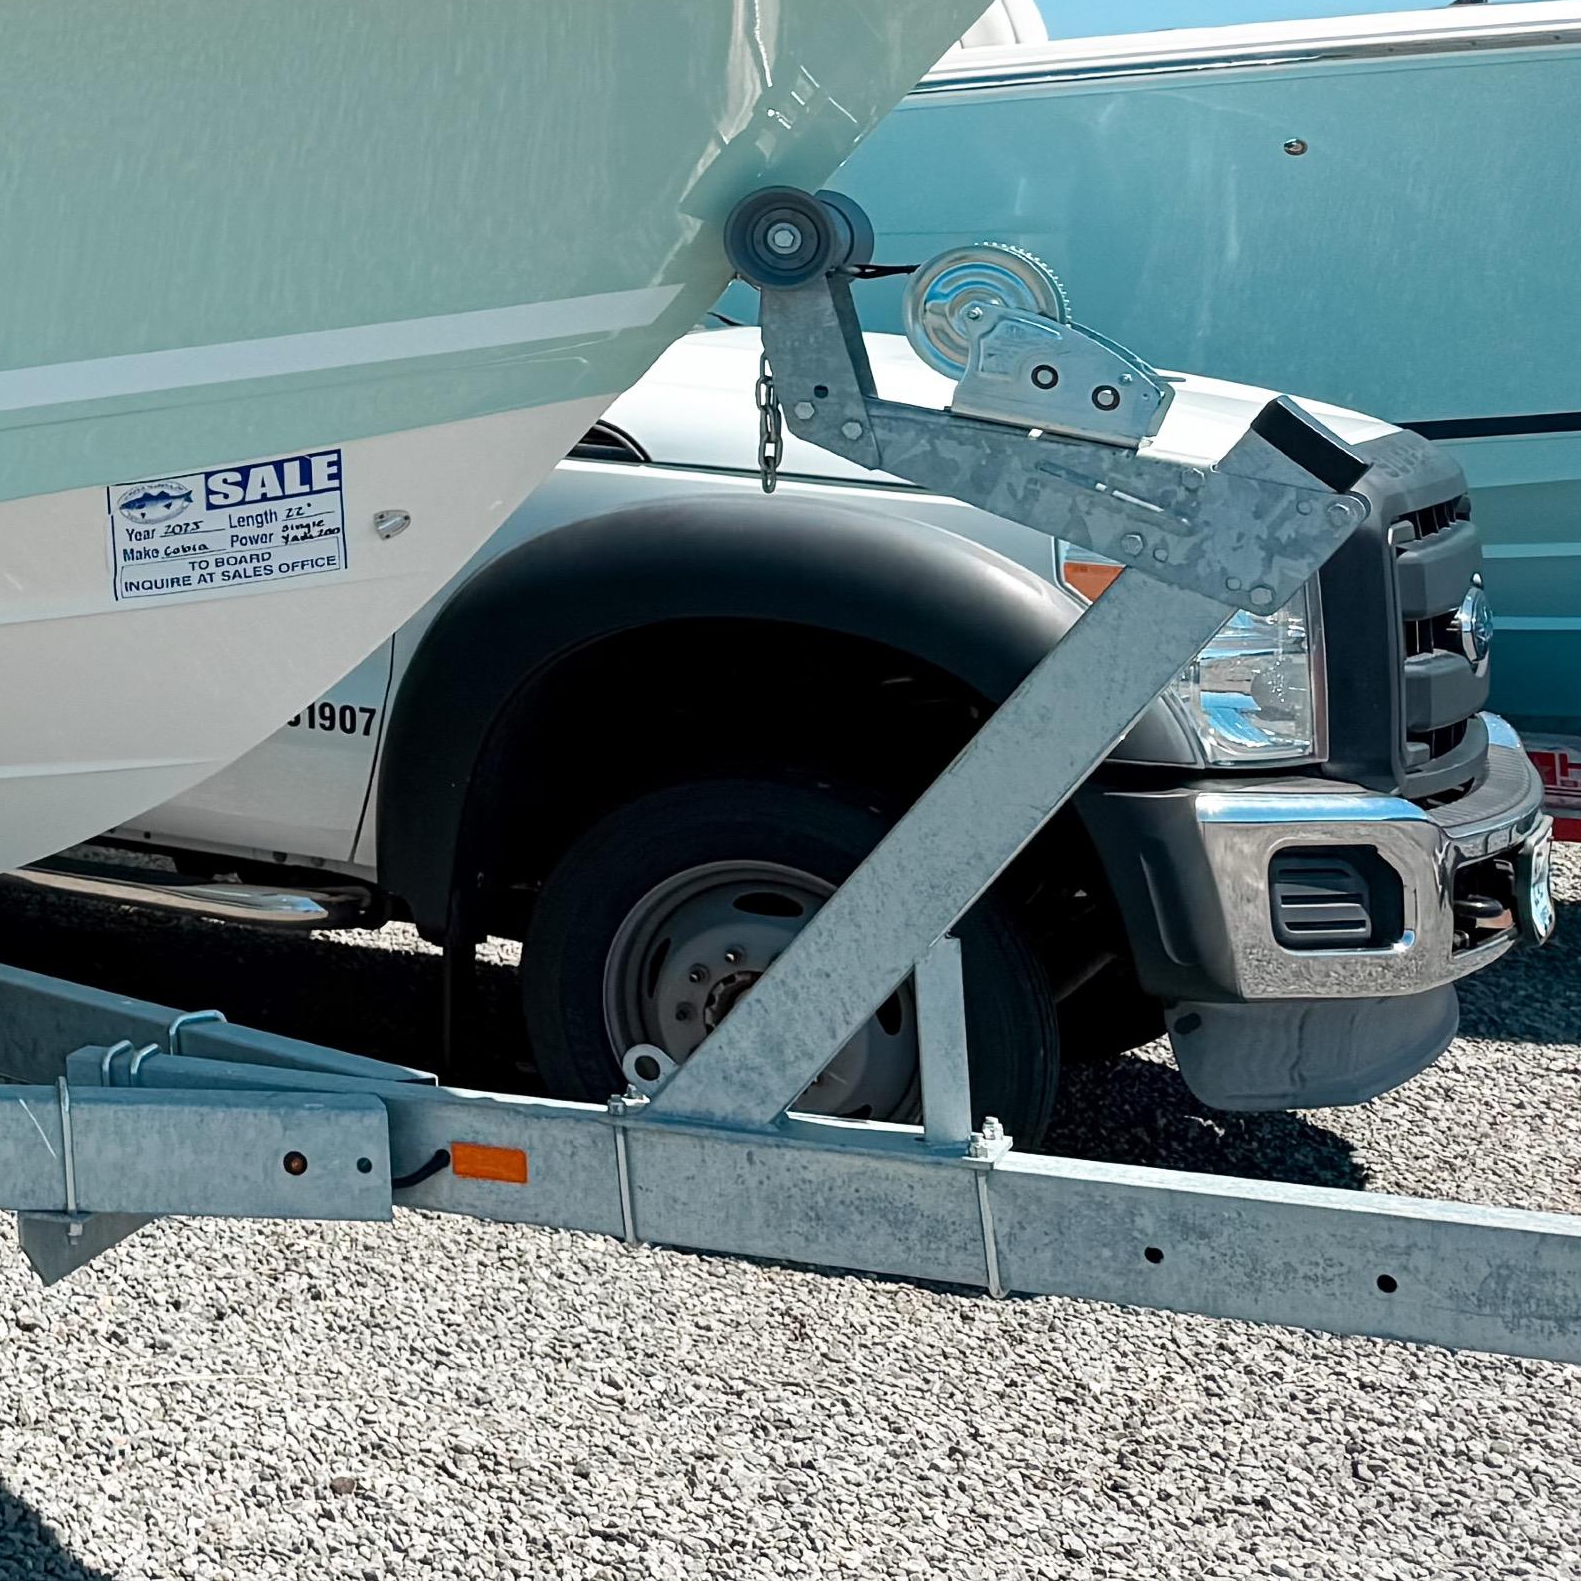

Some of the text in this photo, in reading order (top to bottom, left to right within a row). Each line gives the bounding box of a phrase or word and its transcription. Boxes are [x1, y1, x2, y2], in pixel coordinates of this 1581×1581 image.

[206, 453, 340, 506] SALE
[228, 510, 278, 532] Length
[126, 526, 157, 542] Year
[230, 532, 275, 549] Power
[122, 546, 160, 563] Make
[188, 551, 272, 572] TO BOARD
[124, 555, 337, 593] INQUIRE AT SALES OFFICE
